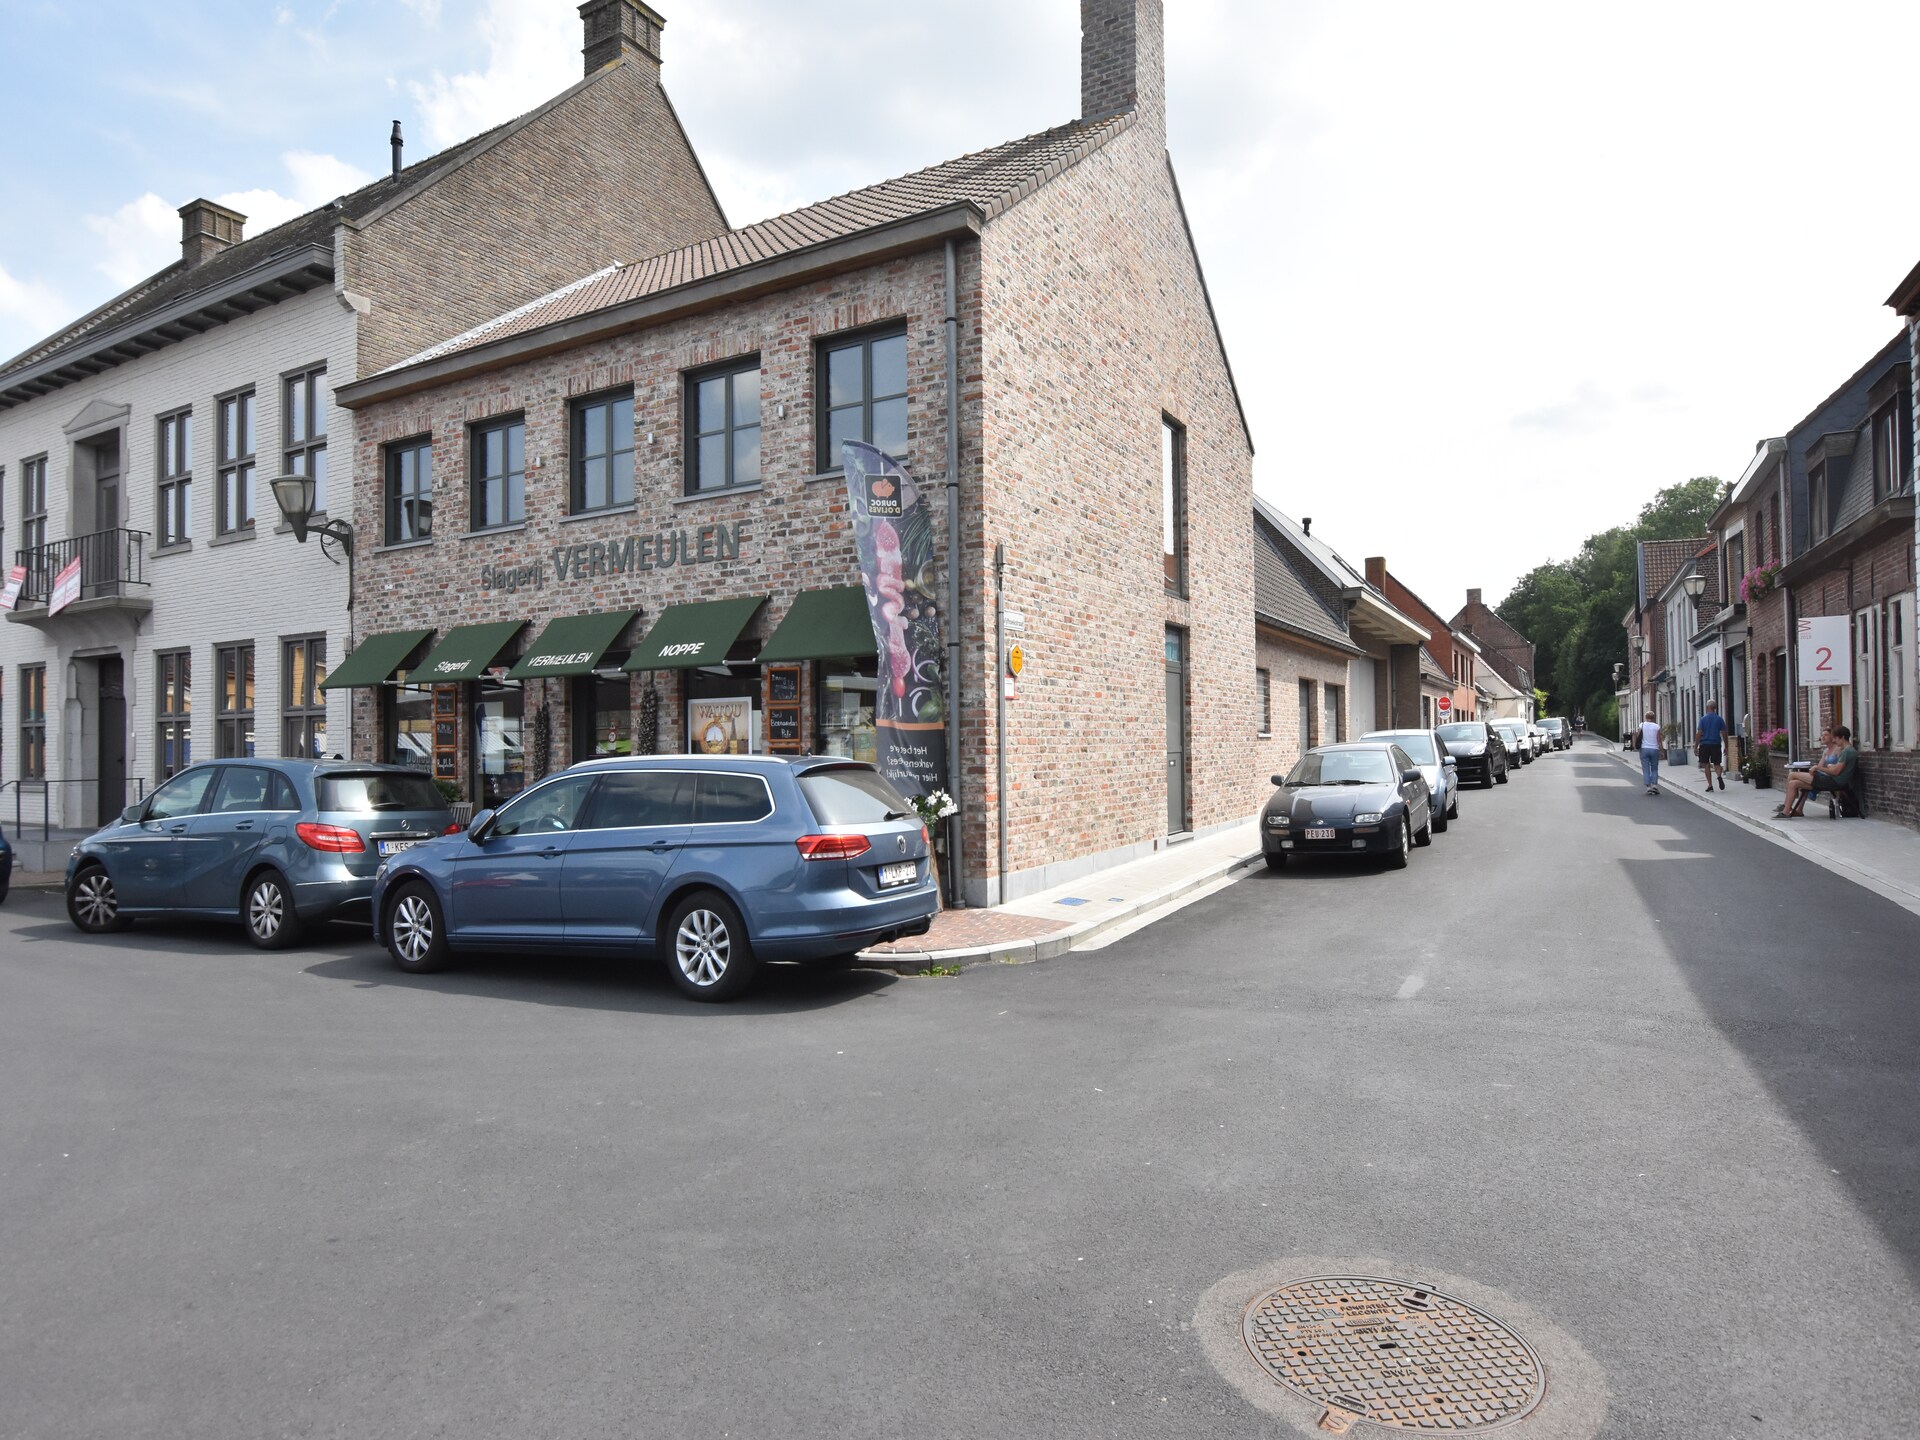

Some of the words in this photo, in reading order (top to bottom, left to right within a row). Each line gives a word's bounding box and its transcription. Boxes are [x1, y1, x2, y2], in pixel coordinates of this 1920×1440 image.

[481, 560, 543, 594] Slagerij
[552, 522, 741, 581] VERMEULEN
[658, 642, 705, 657] NOPPE
[434, 659, 472, 673] Slagerij
[527, 652, 594, 668] VERMEULEN
[1815, 646, 1833, 671] 2
[697, 703, 743, 719] WATOU
